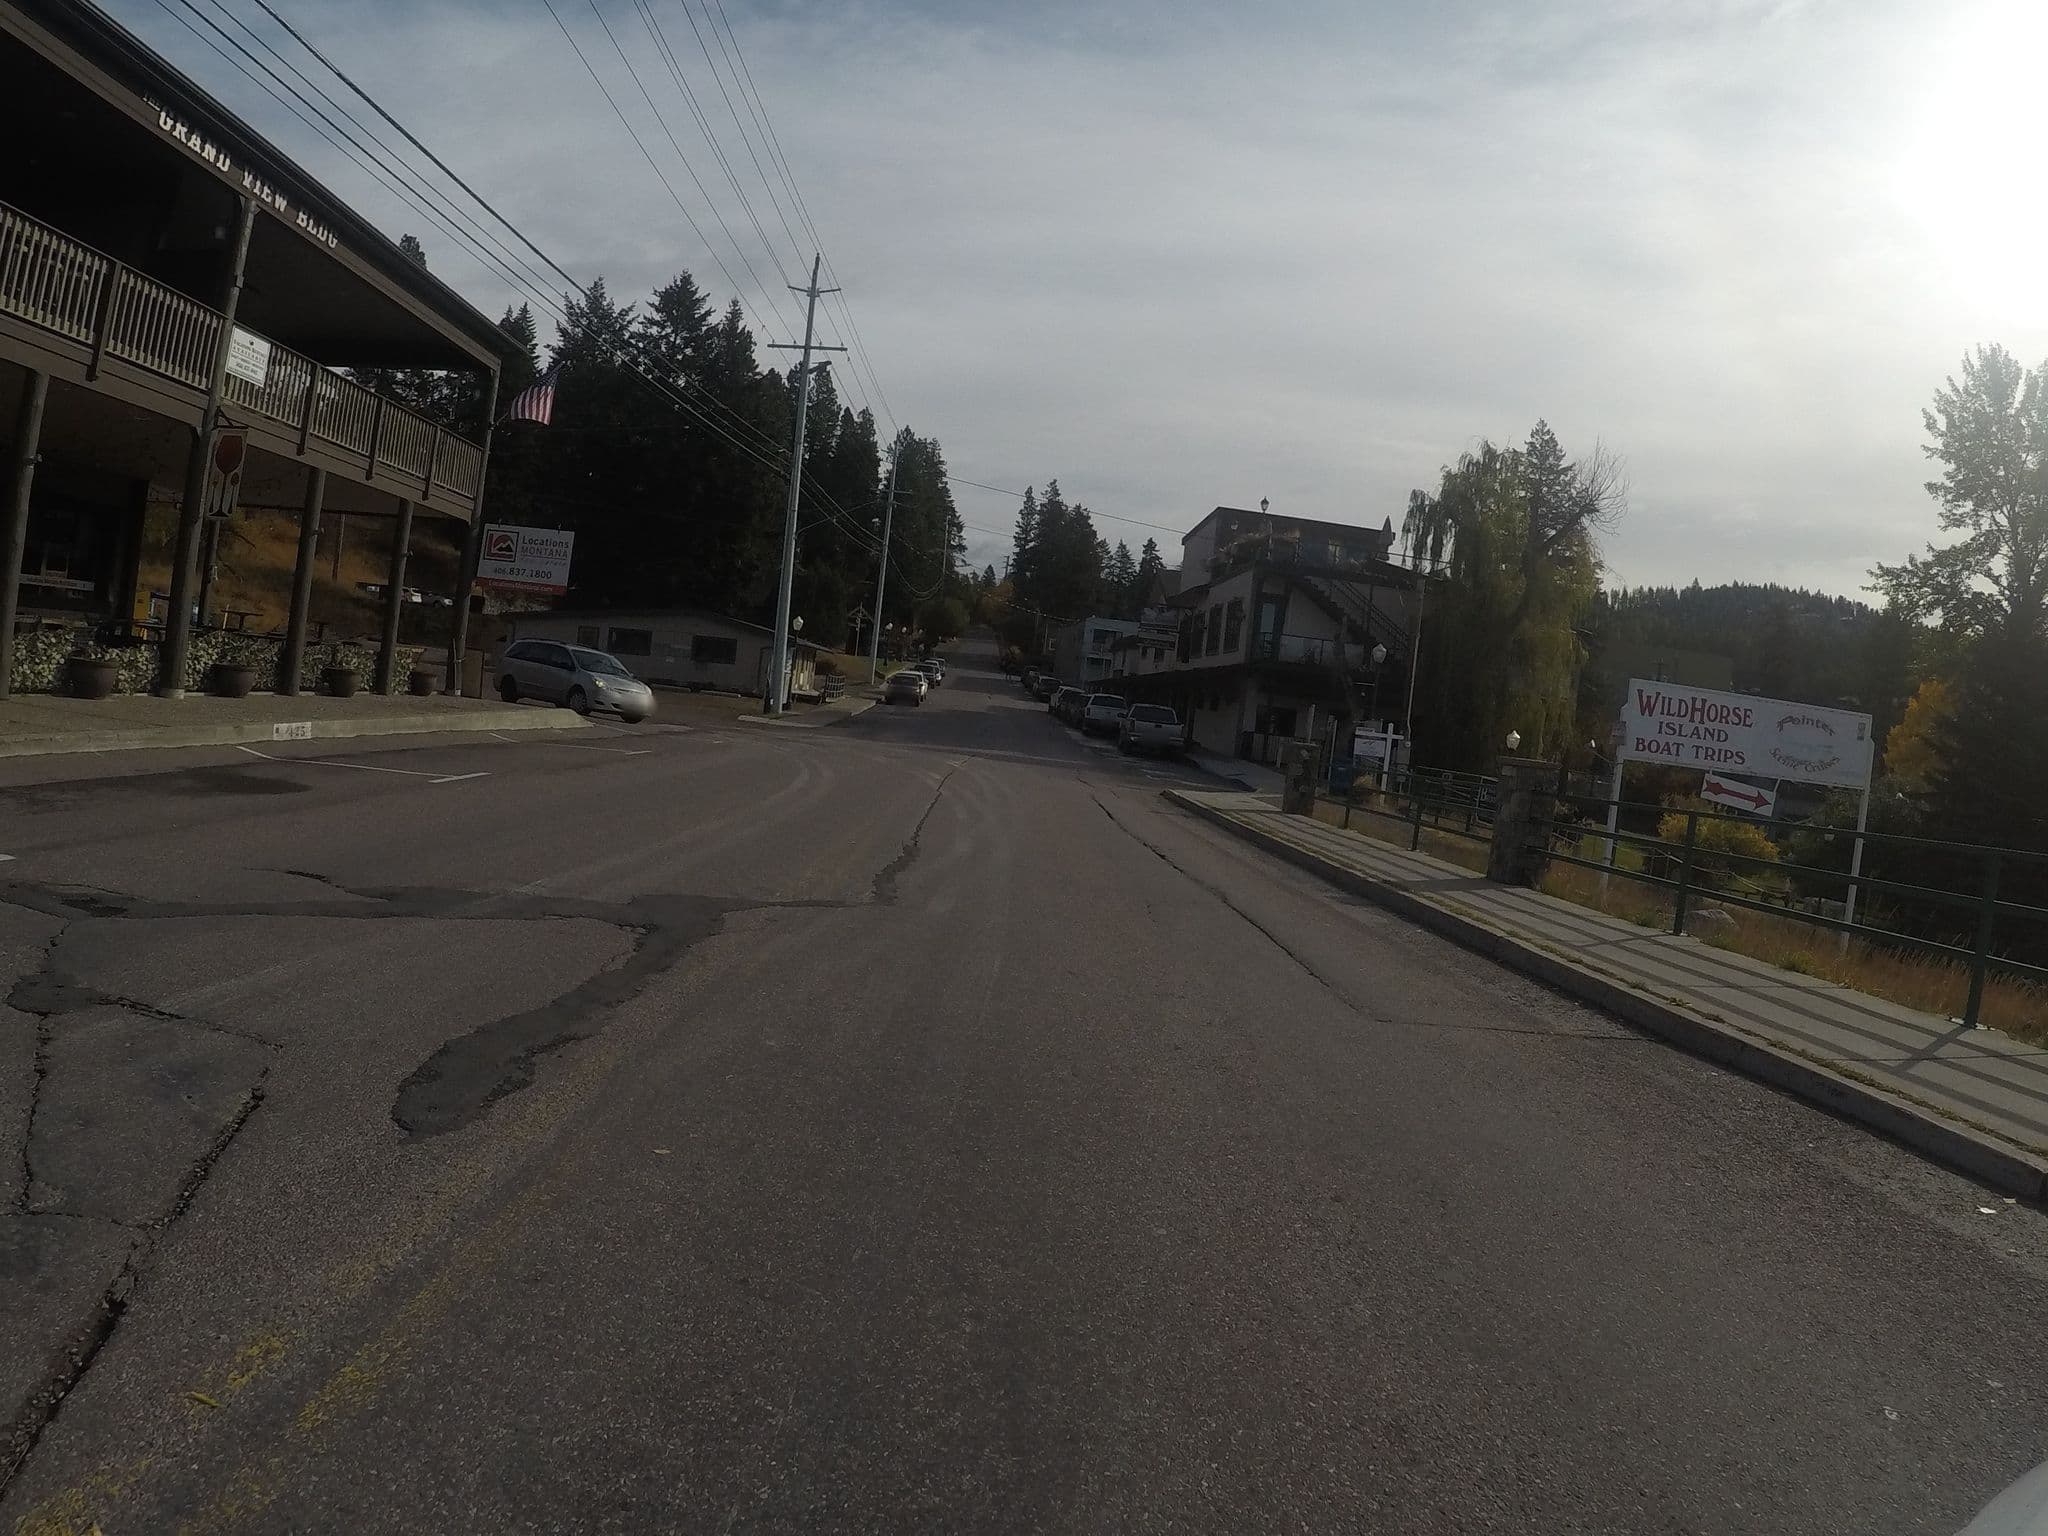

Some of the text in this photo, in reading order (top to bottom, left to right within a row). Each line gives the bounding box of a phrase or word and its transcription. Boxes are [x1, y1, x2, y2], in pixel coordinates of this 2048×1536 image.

[522, 535, 569, 549] Locations
[521, 546, 568, 558] MONTANA
[1657, 721, 1729, 742] ISLAND
[1634, 737, 1746, 765] BOAT TRIPS
